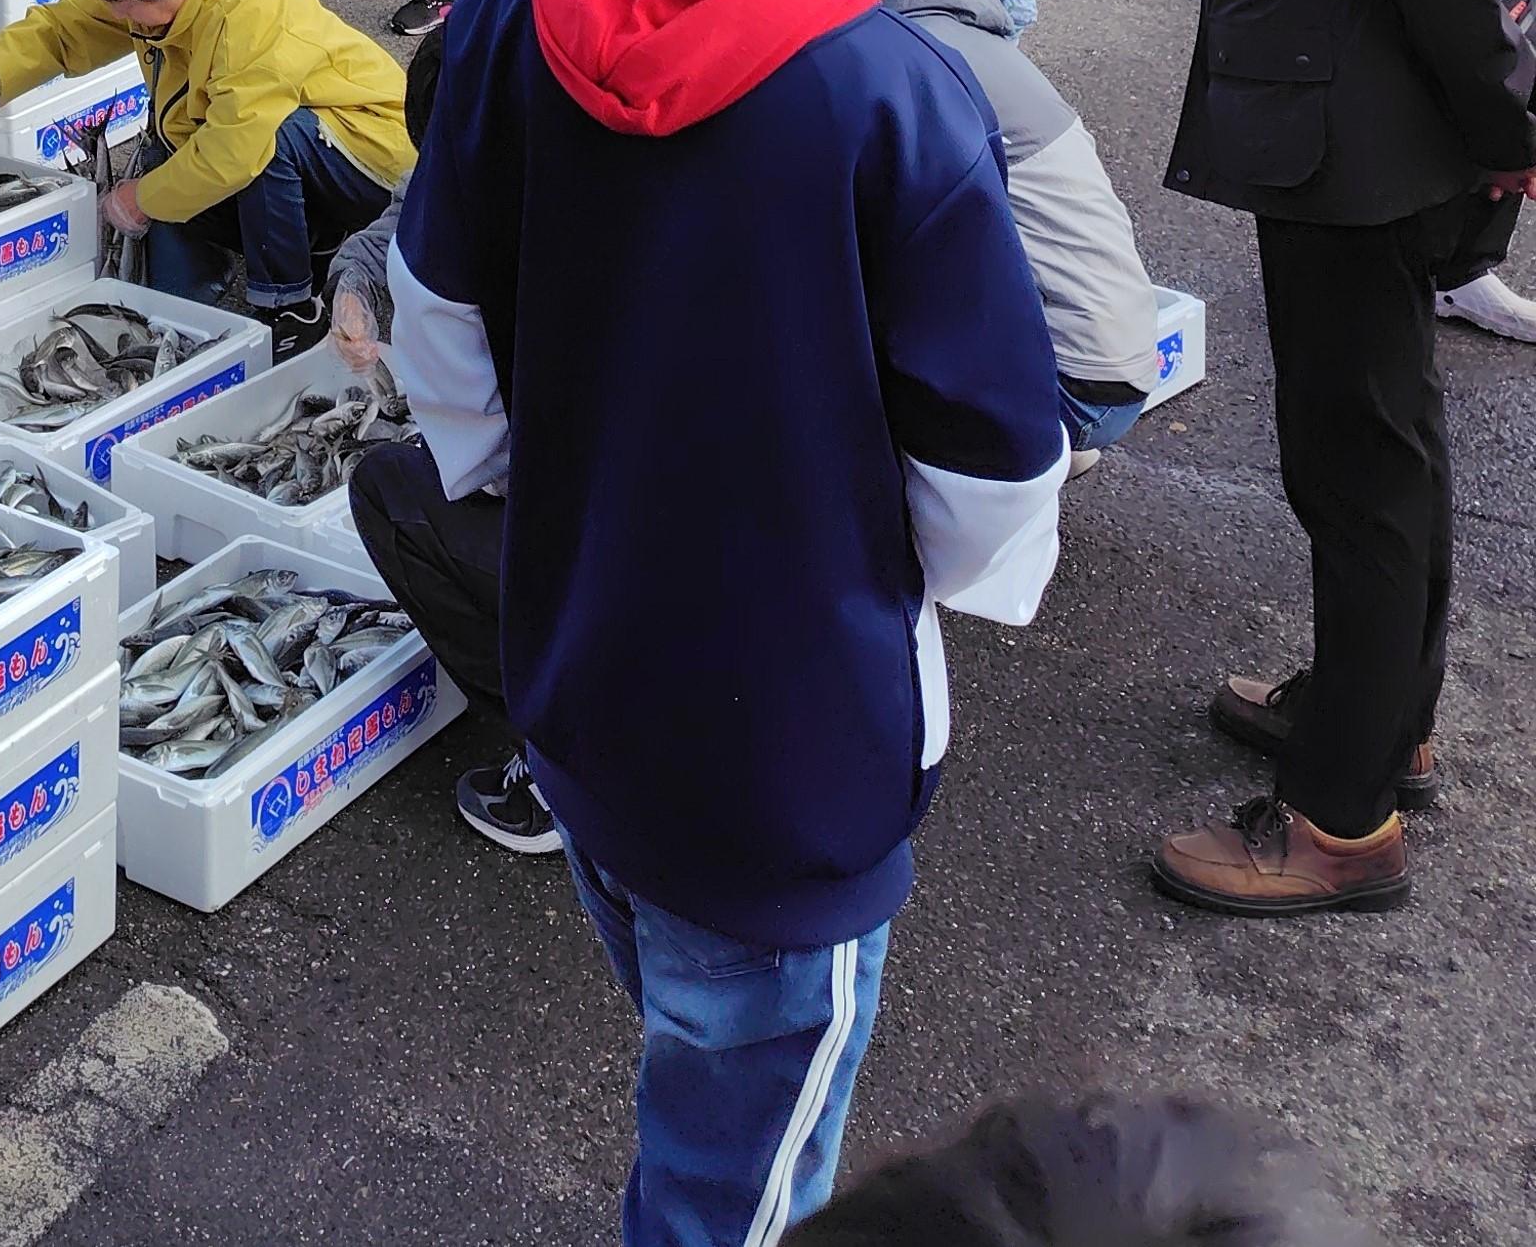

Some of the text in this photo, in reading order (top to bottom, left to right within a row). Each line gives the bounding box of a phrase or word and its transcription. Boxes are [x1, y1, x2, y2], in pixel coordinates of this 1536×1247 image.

[296, 689, 412, 797] しまね定置もん
